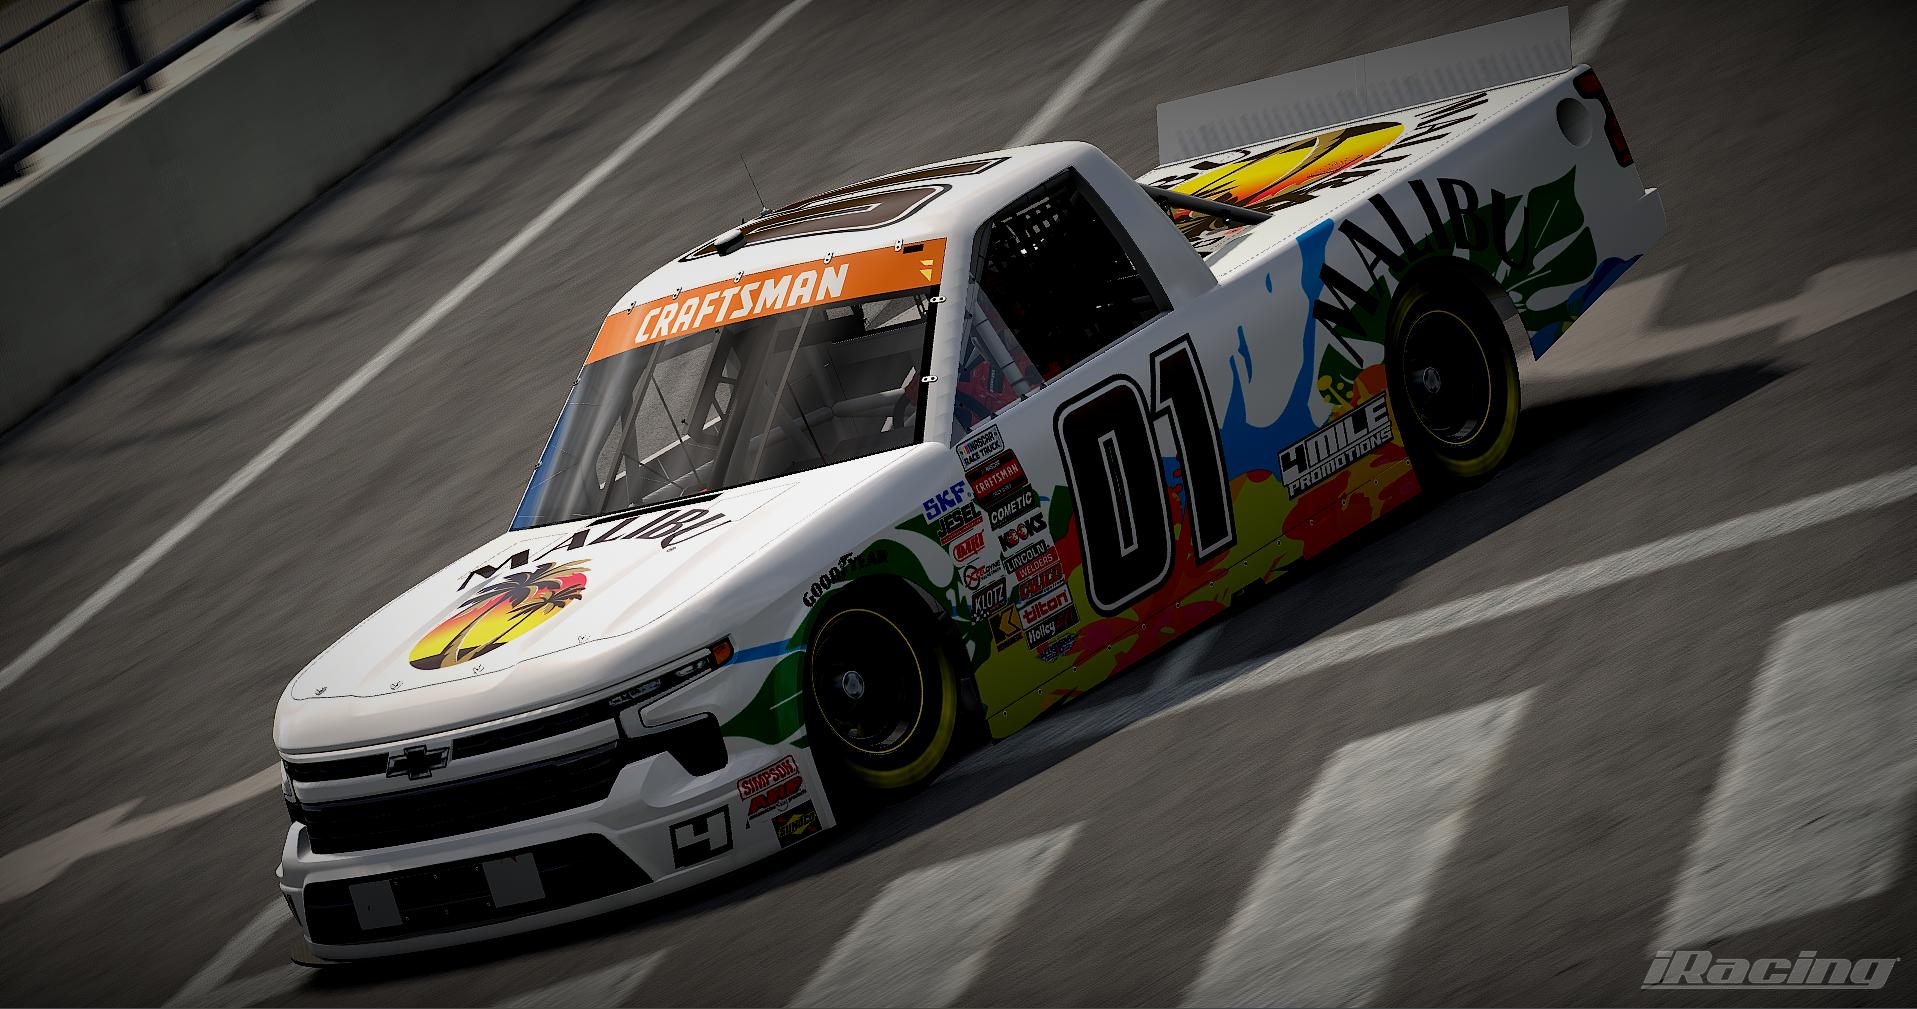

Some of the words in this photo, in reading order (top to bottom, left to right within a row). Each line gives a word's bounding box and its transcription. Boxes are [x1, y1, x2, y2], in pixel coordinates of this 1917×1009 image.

[1313, 178, 1529, 368] MALIBU
[634, 263, 850, 344] CRAFTSMAN
[964, 453, 981, 467] RACE
[981, 442, 1002, 458] TRUCK
[969, 431, 995, 452] NASCAR
[1289, 424, 1393, 498] PROMOTIONS
[975, 463, 1020, 495] CRAFTSMAN
[1053, 333, 1237, 617] 01
[922, 480, 966, 521] SKF
[990, 491, 1034, 524] COMETIC
[457, 508, 732, 592] MALIBU
[999, 511, 1048, 553] KOOKS
[1005, 541, 1046, 572] LINCOLN
[1019, 553, 1054, 578] WELDERS
[802, 549, 889, 608] GOODYEAR
[974, 582, 1004, 615] KLOTZ
[1022, 591, 1069, 624] tilton
[1027, 620, 1057, 645] Holley
[741, 758, 795, 797] SIMPSON
[748, 774, 804, 817] ARP
